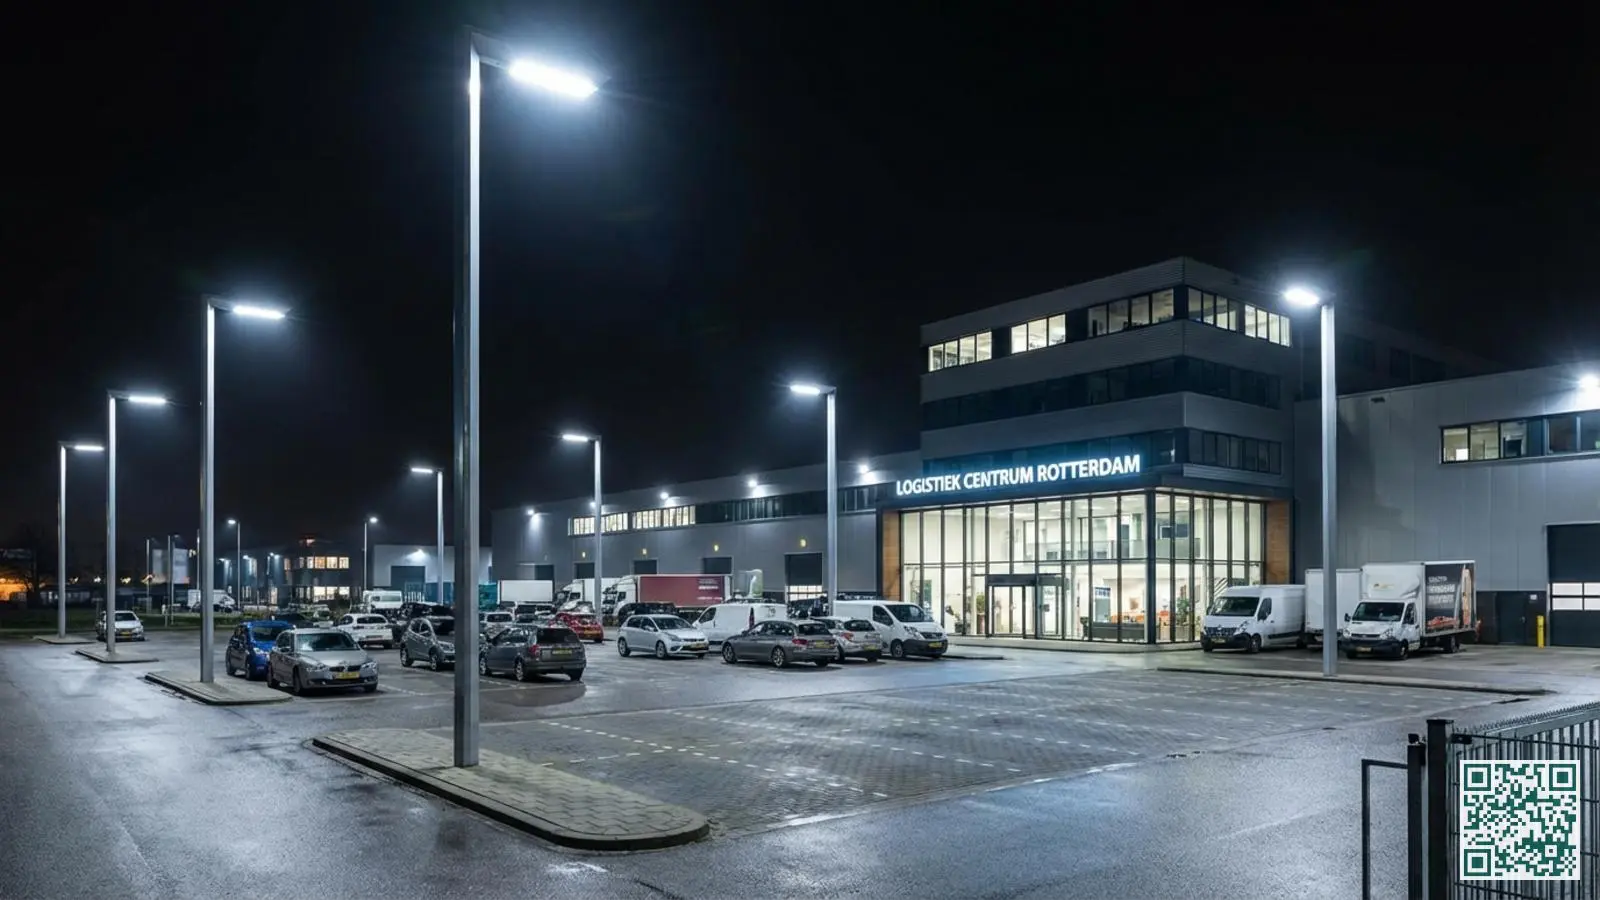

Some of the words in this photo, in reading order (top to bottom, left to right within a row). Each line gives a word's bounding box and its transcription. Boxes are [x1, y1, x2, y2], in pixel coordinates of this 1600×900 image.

[896, 475, 961, 496] LOGISTIEK
[963, 466, 1034, 489] CENTRUM
[1037, 454, 1140, 482] ROTTERDAM
